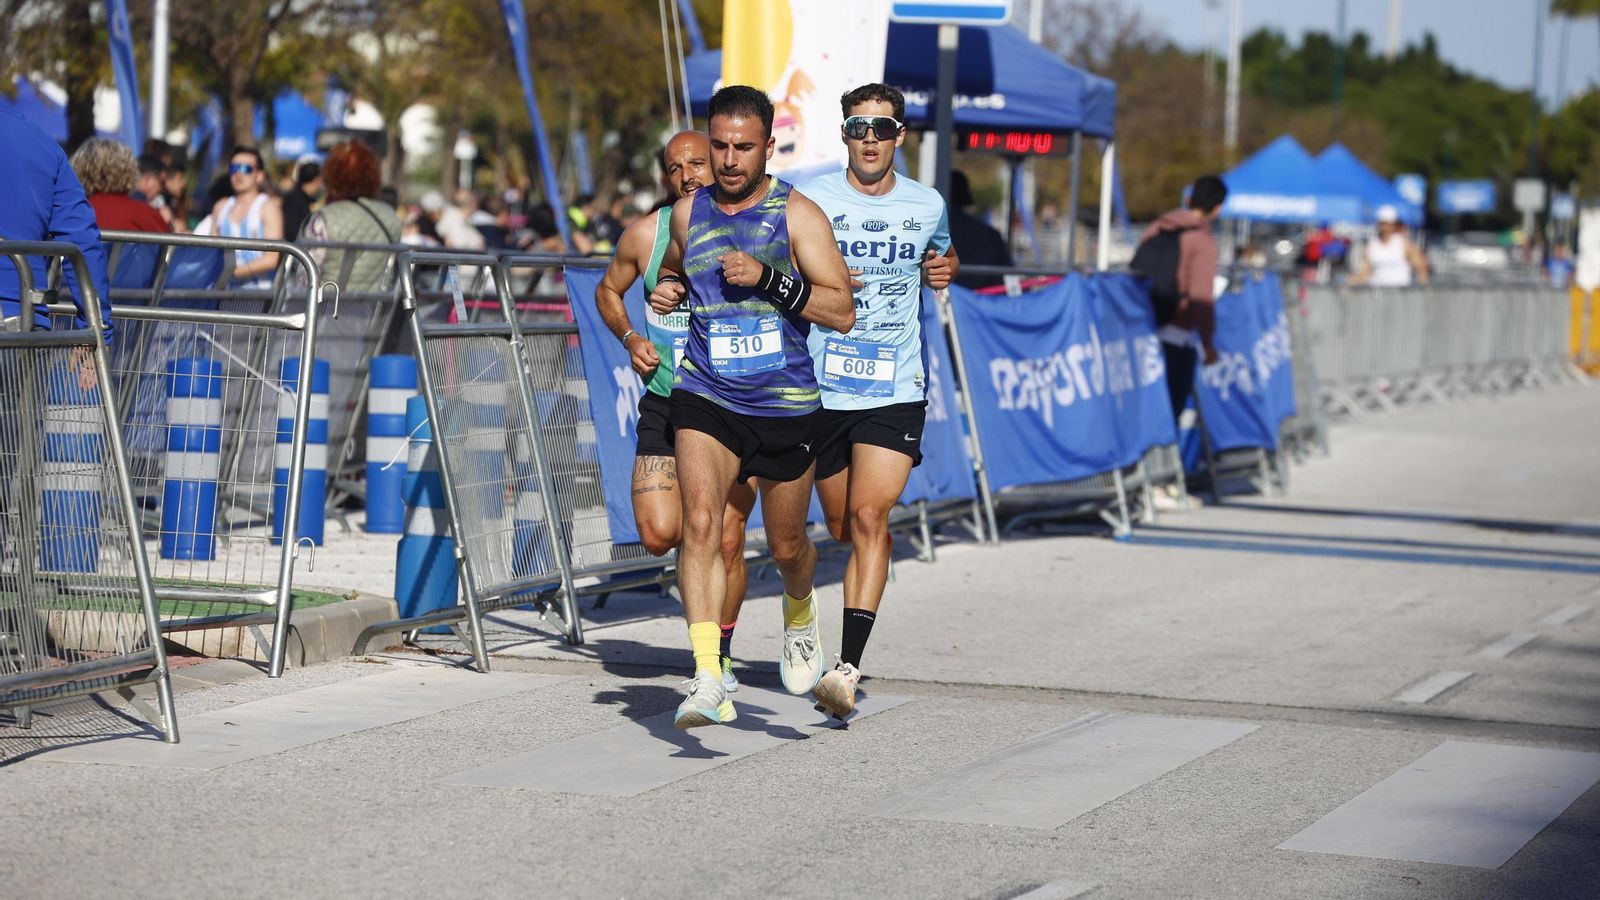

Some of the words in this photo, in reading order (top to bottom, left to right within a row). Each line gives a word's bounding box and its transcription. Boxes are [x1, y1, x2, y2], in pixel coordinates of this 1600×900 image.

[863, 221, 888, 231] TROPS
[903, 217, 921, 230] als
[837, 235, 916, 264] nerja
[730, 336, 763, 355] 510
[843, 358, 876, 376] 608
